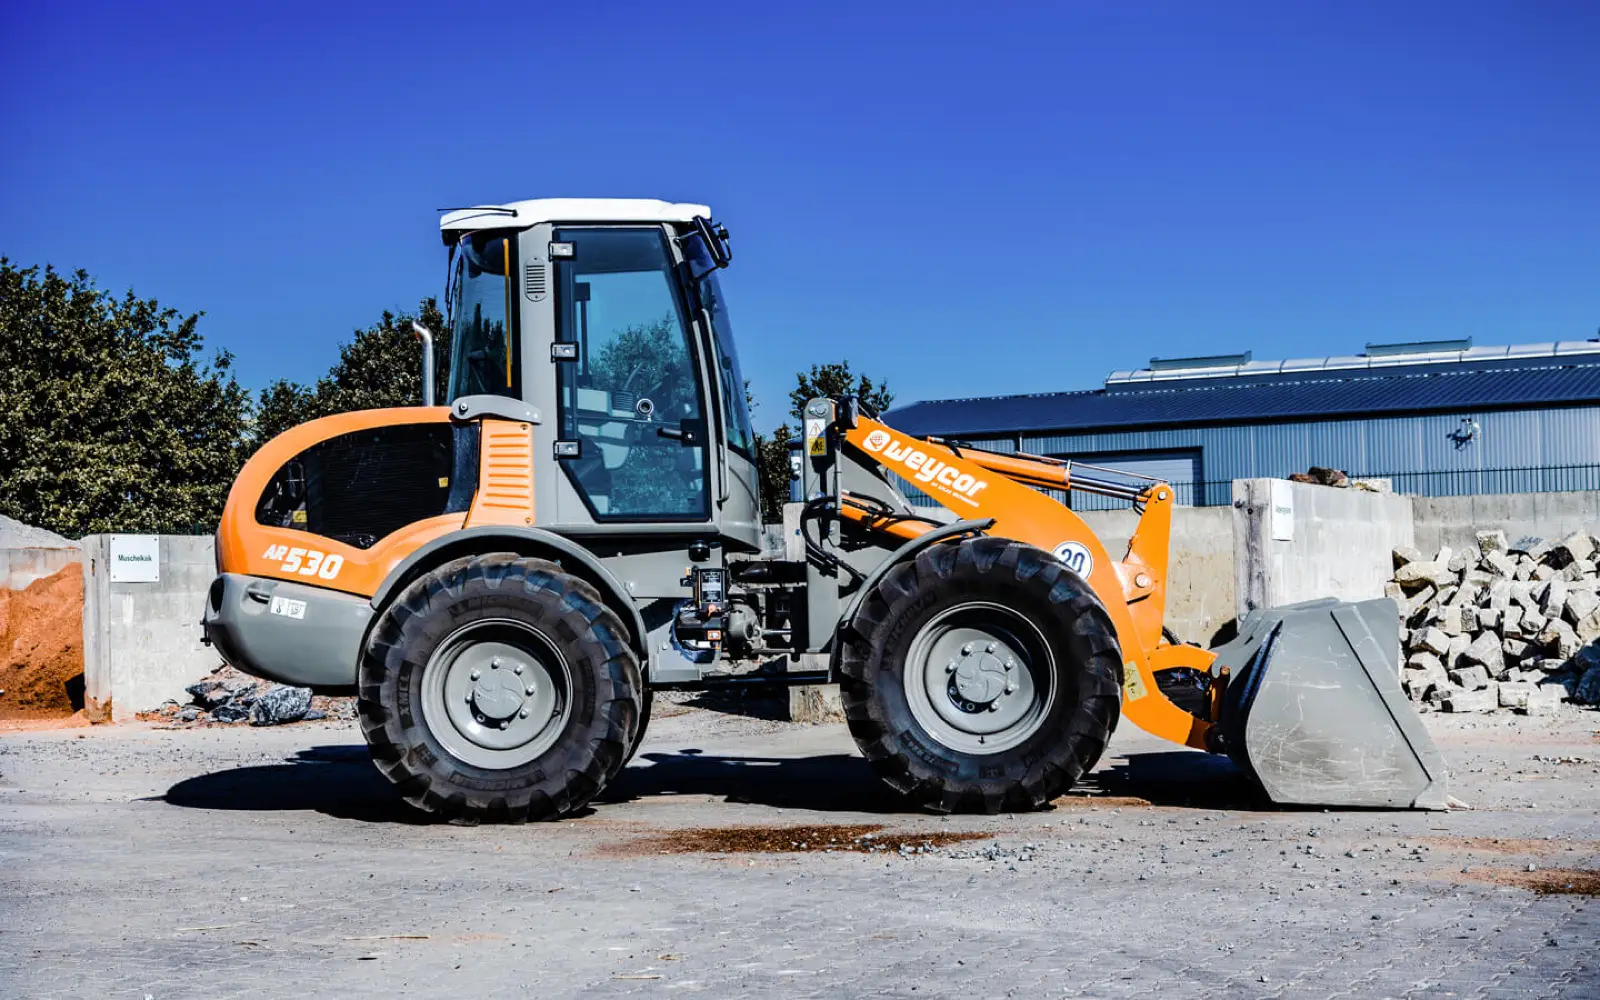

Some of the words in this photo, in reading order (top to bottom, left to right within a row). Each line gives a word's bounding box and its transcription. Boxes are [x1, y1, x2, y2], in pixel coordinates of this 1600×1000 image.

[262, 544, 289, 560] AR
[280, 547, 345, 580] 530
[1061, 548, 1086, 572] 20
